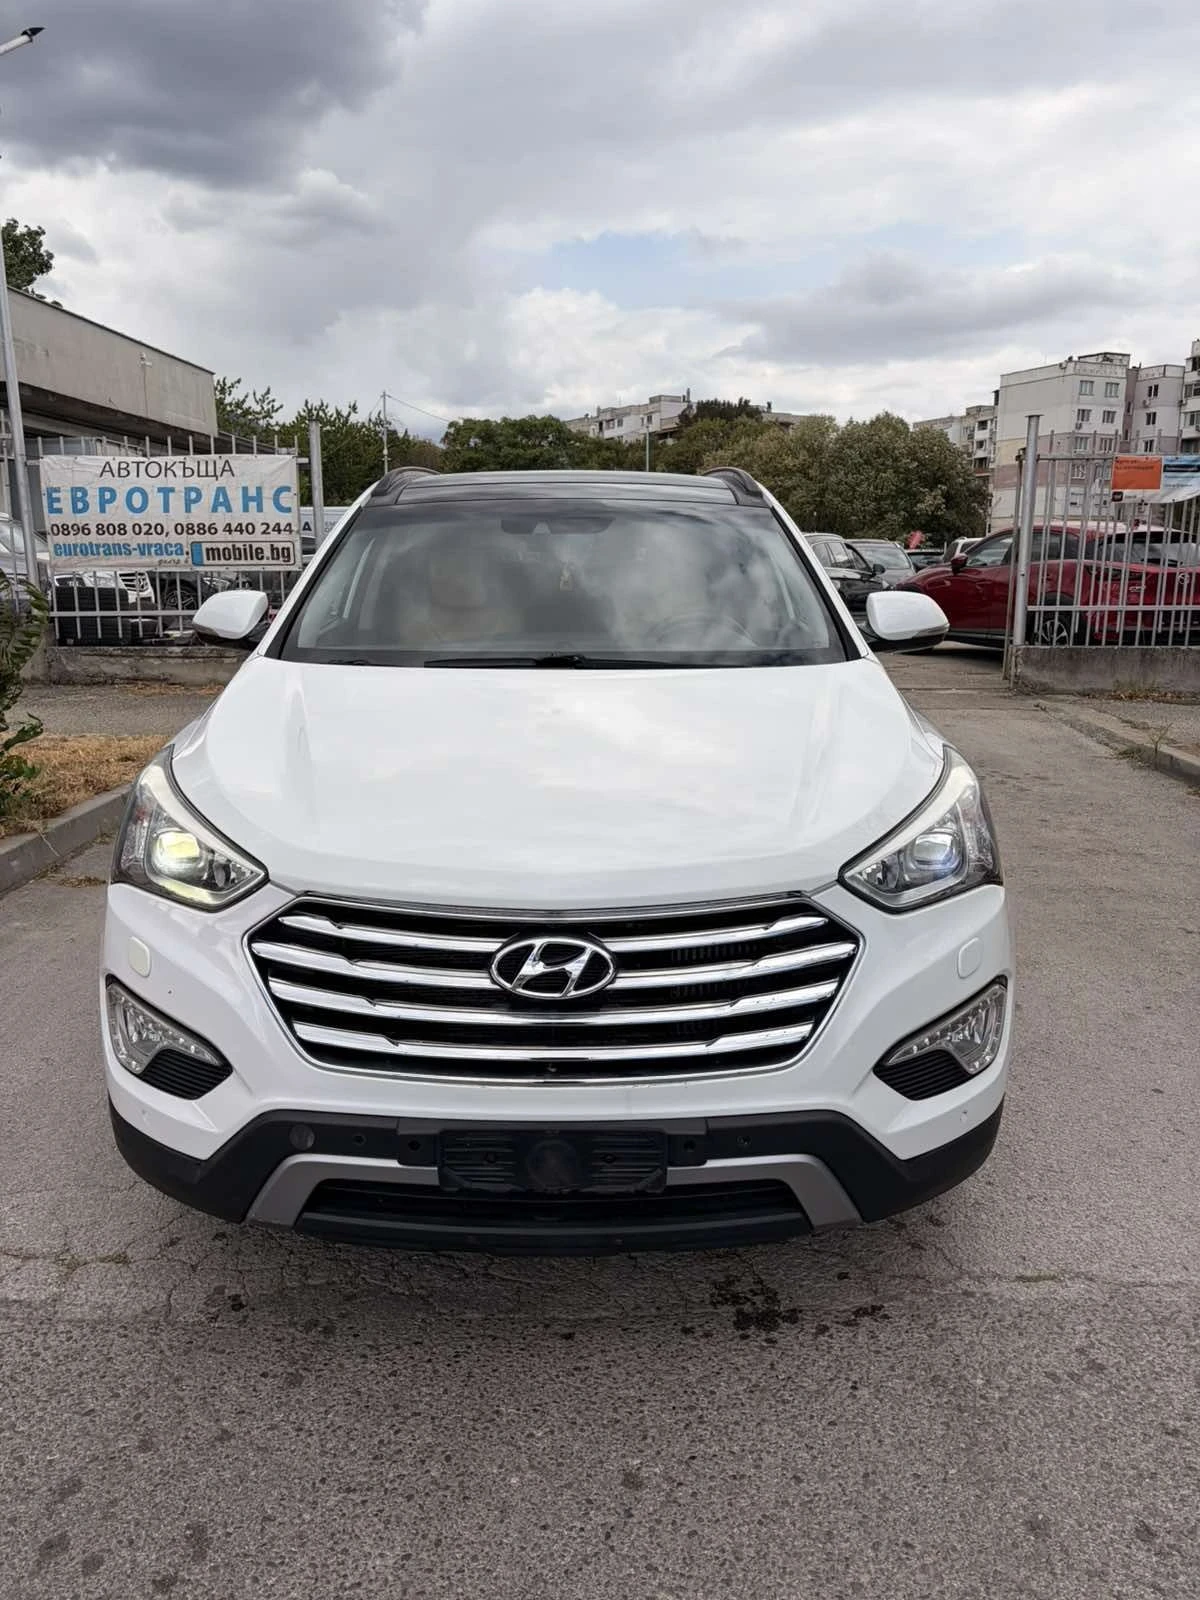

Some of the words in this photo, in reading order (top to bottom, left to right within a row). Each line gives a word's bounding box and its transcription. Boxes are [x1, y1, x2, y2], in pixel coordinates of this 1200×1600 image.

[99, 460, 235, 481] АВТОКЪЩА
[46, 485, 293, 514] ЕВРОТРАНС
[50, 523, 91, 537] 0896
[95, 522, 128, 536] 808
[132, 522, 169, 538] 020,
[174, 522, 218, 536] 0886
[222, 522, 256, 535] 440
[260, 522, 294, 536] 244
[205, 543, 292, 563] mobile.bg
